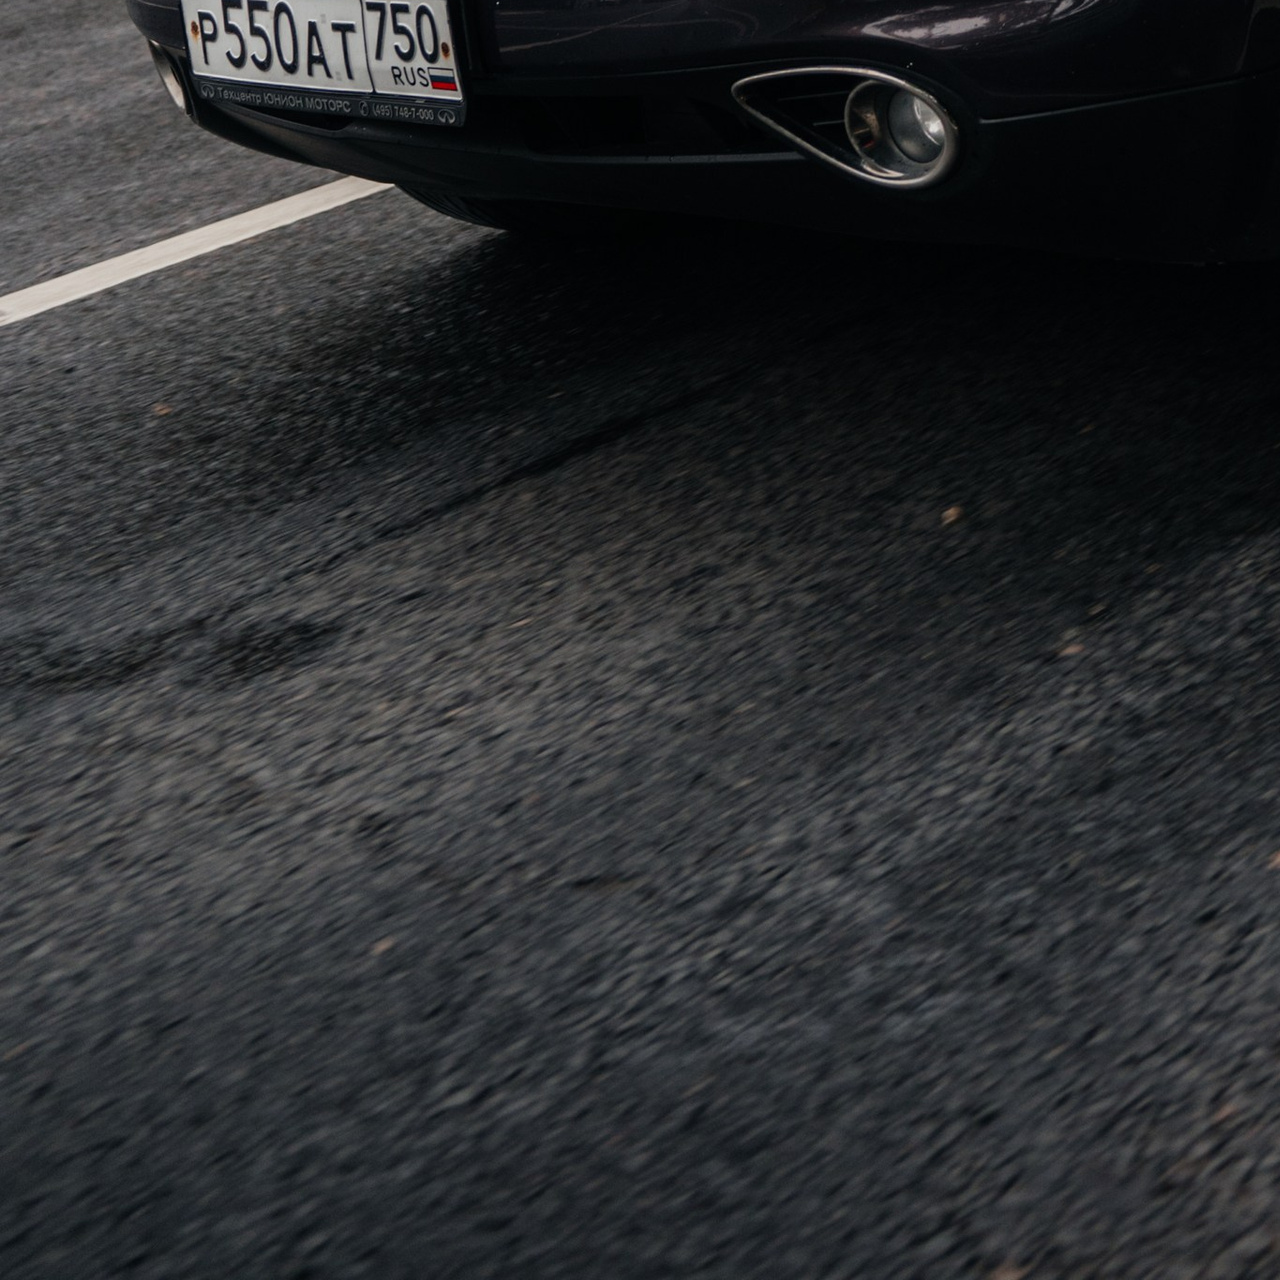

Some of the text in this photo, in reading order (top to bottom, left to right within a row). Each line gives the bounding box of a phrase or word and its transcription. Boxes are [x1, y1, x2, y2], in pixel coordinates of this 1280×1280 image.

[365, 1, 438, 63] 750
[392, 66, 429, 88] RUS
[217, 87, 262, 105] Техцентр
[263, 92, 304, 108] ЮНИОН
[305, 97, 352, 113] МОТОРС
[372, 102, 394, 118] (495)
